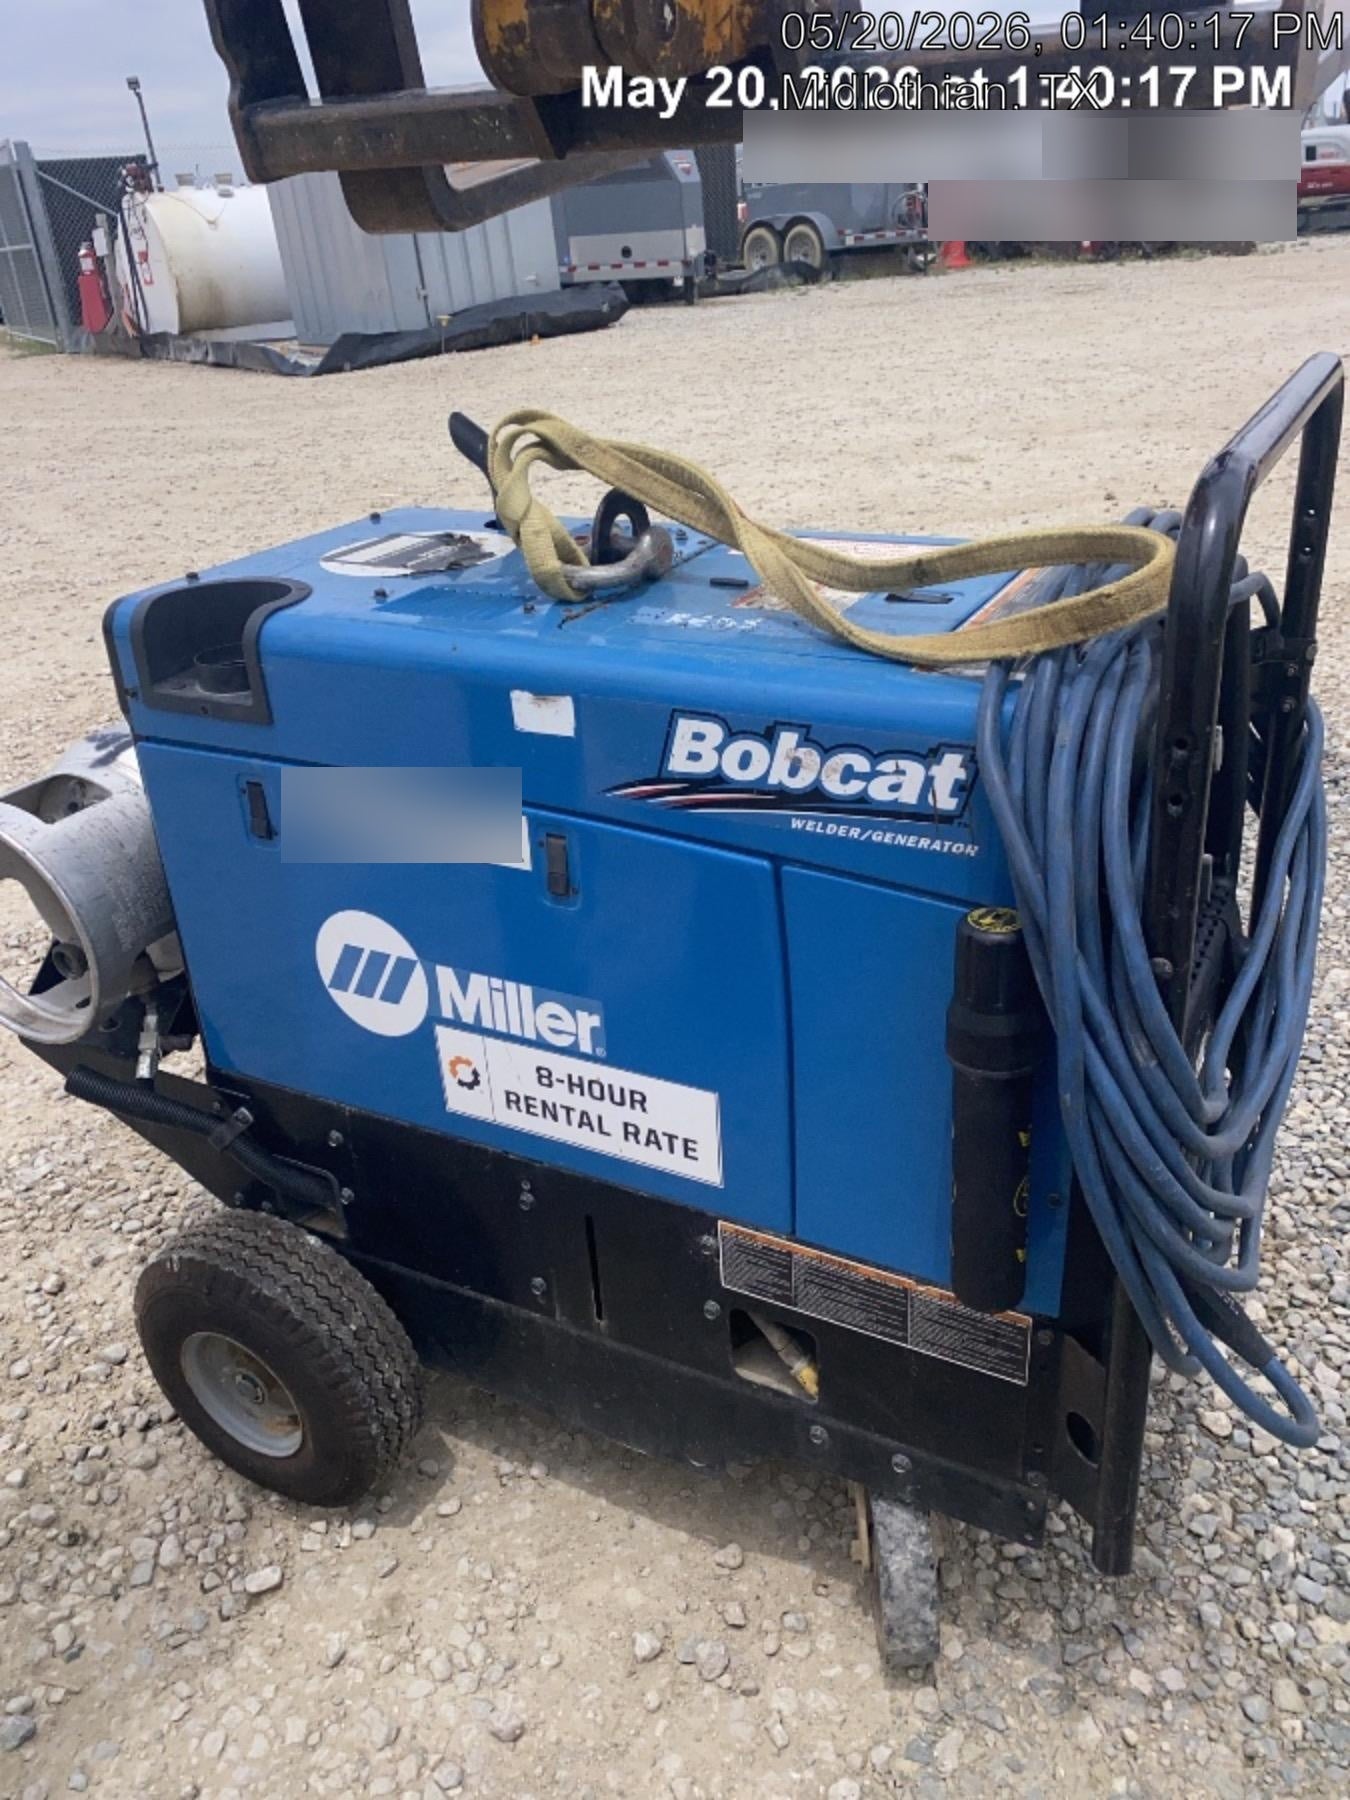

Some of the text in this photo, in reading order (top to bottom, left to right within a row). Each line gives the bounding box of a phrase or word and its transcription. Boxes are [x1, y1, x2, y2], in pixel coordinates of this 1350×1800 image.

[666, 716, 969, 811] Bobcat
[790, 817, 979, 857] WELDER/GENERATOR
[435, 964, 601, 1056] Miller
[503, 1089, 699, 1161] RENTAL RATE
[535, 1065, 648, 1113] 8-HOUR
